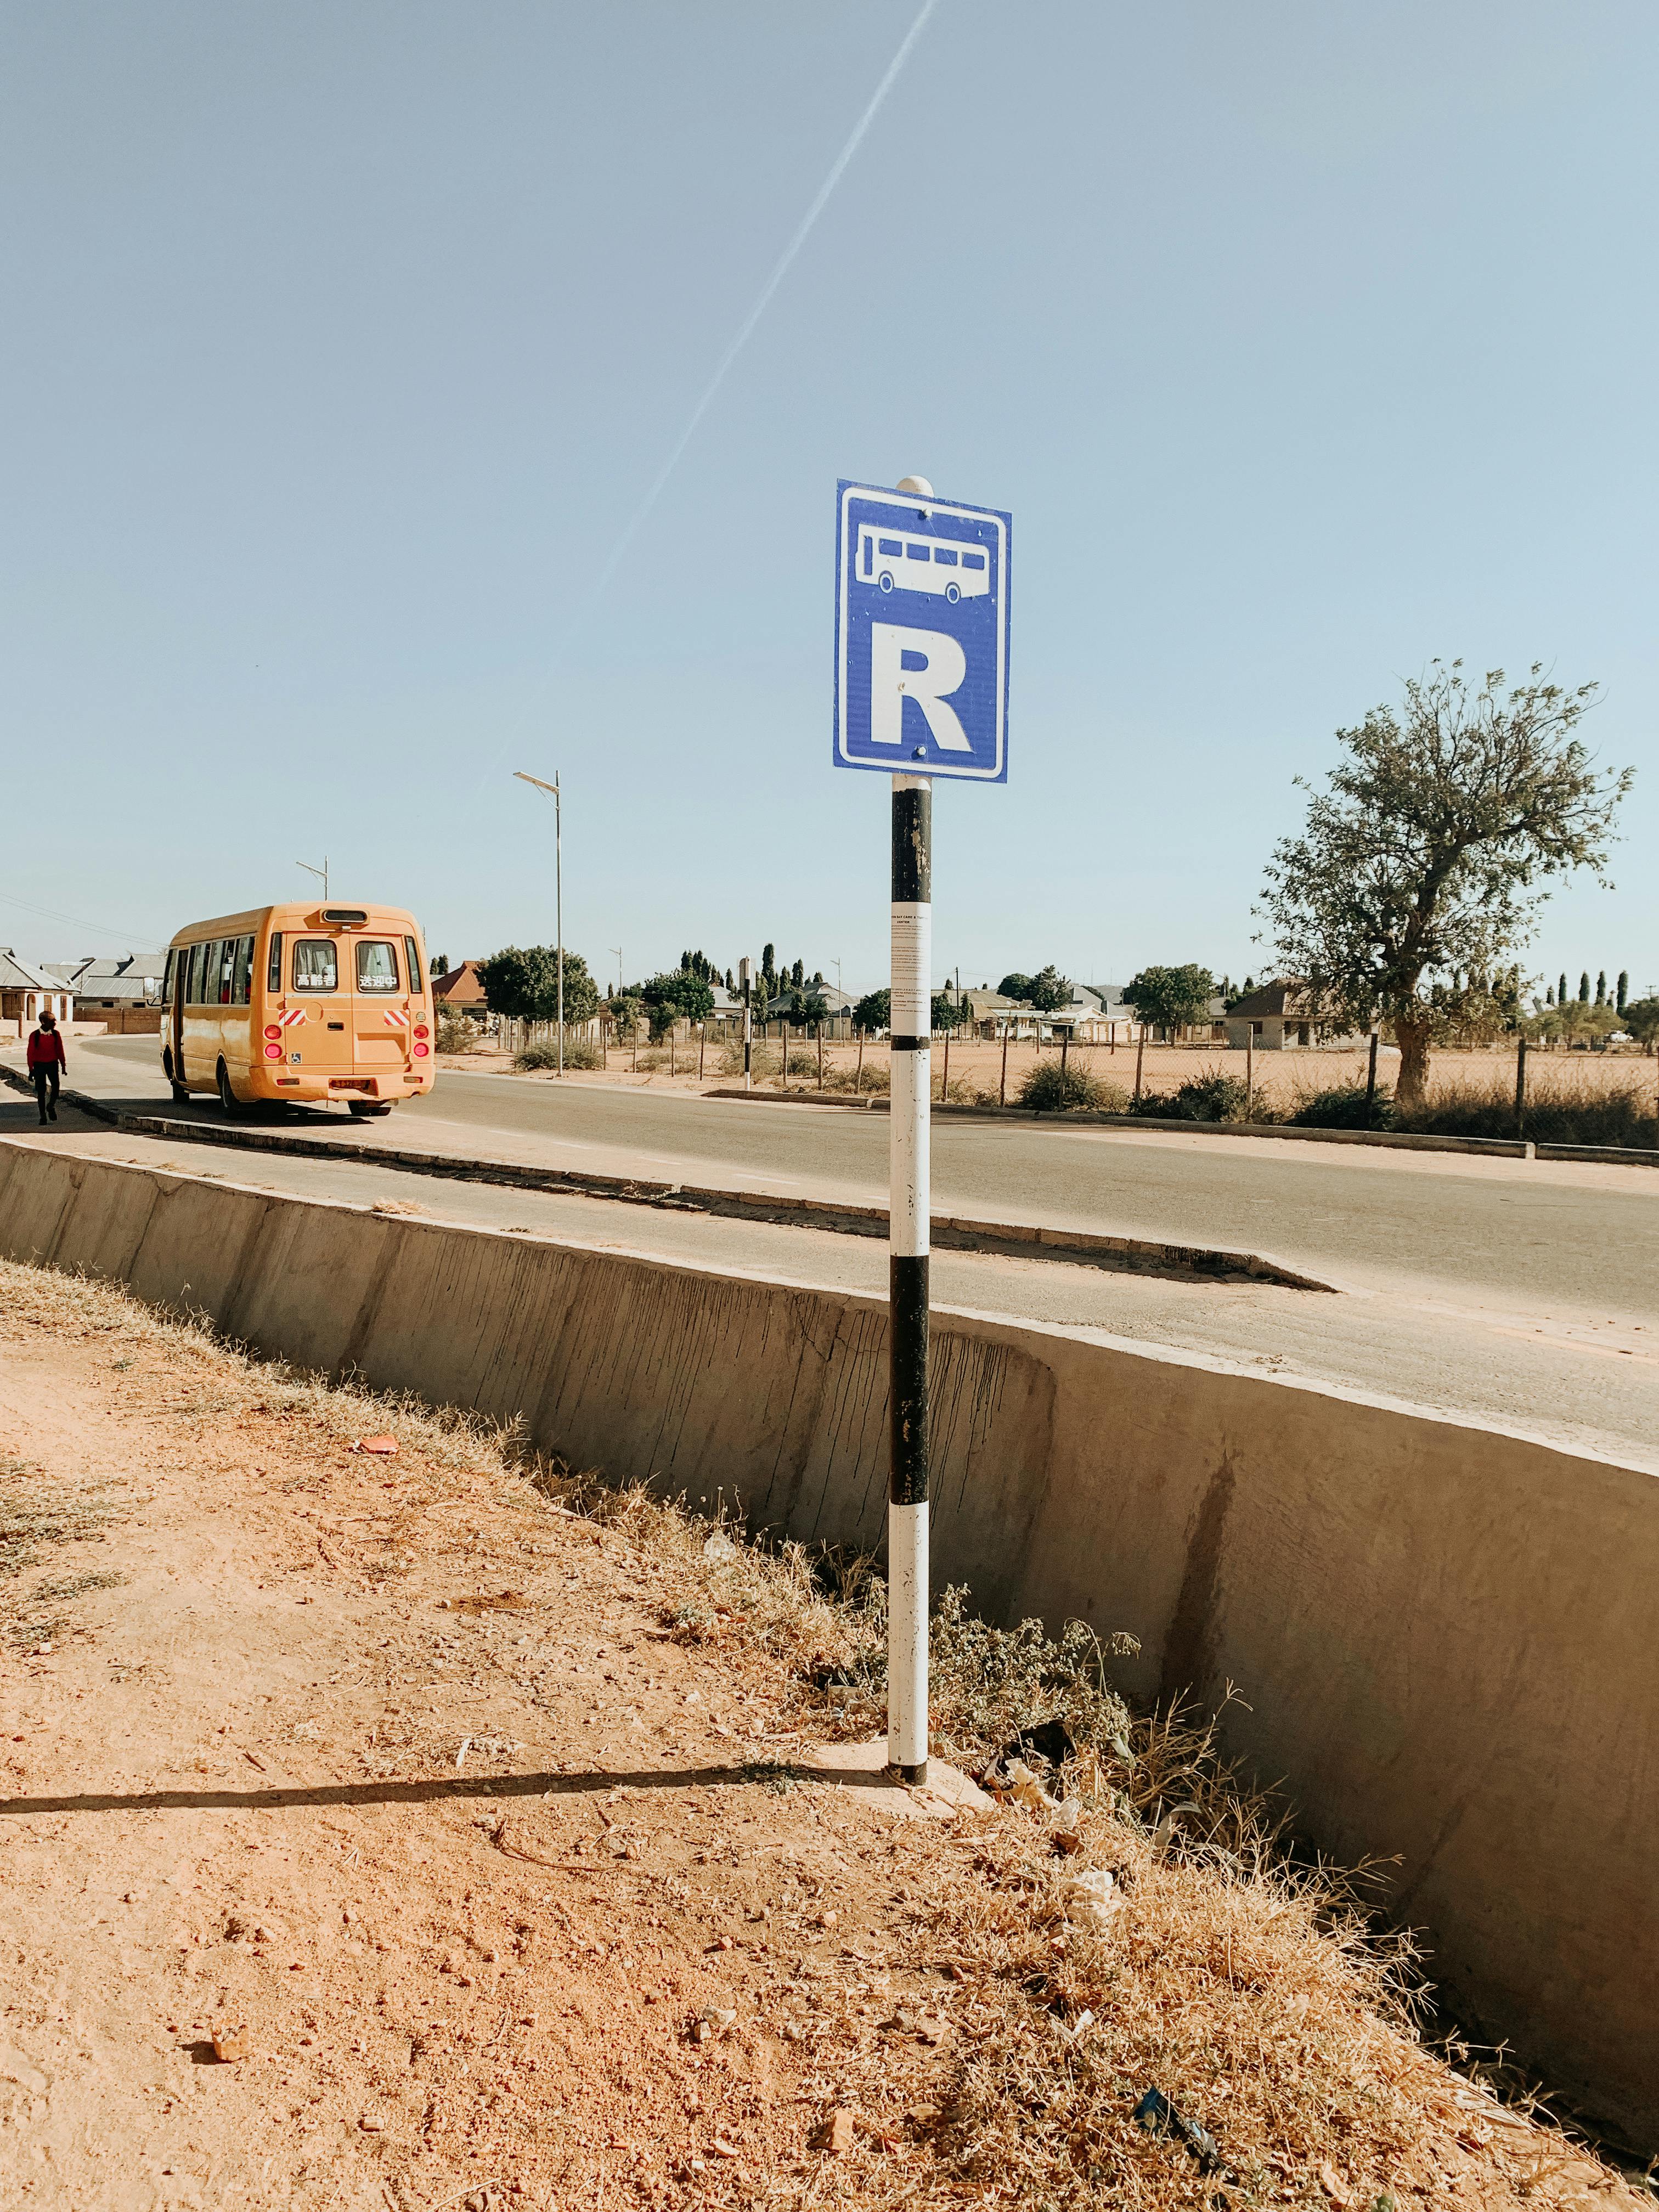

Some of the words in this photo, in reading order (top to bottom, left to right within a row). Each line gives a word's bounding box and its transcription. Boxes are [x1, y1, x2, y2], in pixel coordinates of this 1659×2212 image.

[871, 622, 974, 753] R
[359, 975, 397, 988] 送迎中
